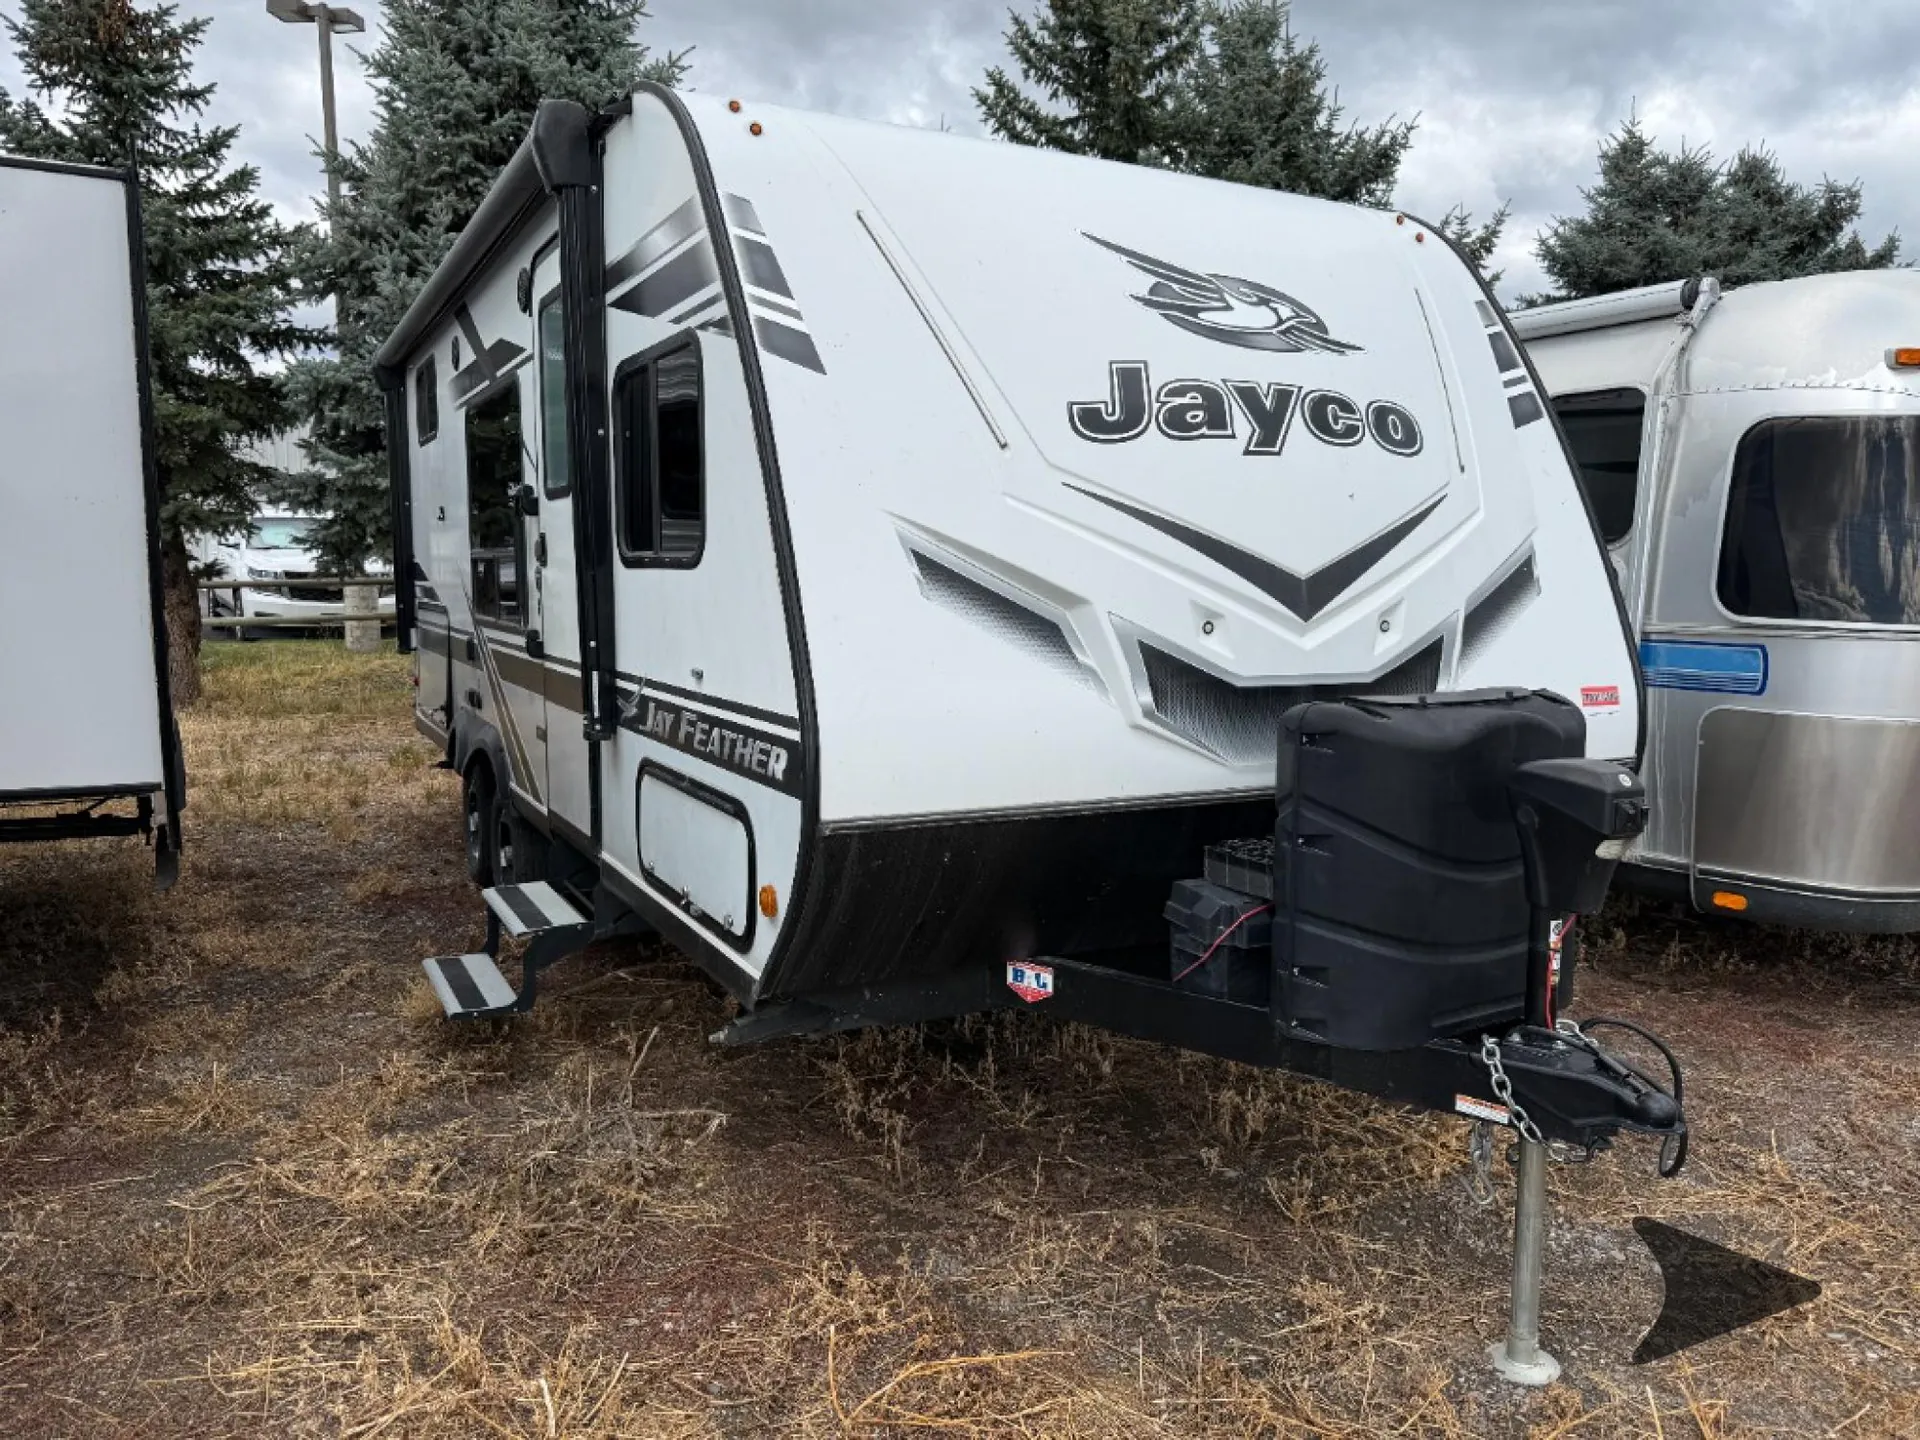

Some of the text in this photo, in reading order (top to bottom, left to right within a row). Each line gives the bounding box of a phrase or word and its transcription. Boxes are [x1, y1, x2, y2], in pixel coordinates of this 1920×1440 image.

[1067, 360, 1423, 456] Jayco
[639, 702, 788, 781] JAY FEATHER
